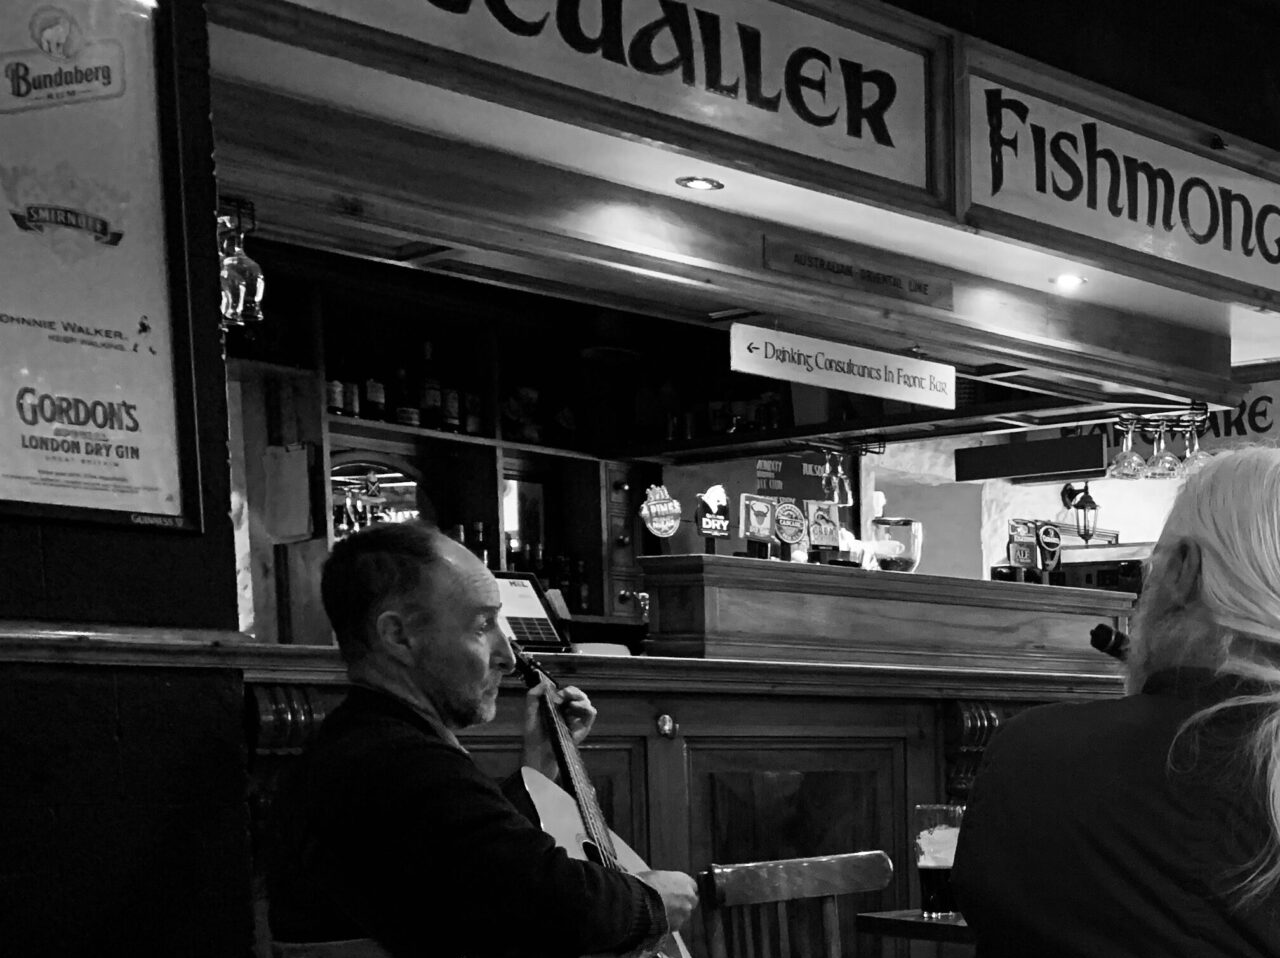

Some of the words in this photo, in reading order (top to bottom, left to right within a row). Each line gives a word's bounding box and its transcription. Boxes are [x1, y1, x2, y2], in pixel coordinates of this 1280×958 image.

[5, 62, 111, 98] Bundaberg
[0, 313, 57, 331] OHNNIE
[764, 342, 813, 372] Drinking
[815, 352, 881, 382] Consultants
[884, 365, 894, 384] In
[897, 368, 926, 389] Front
[929, 375, 948, 396] Bar
[16, 386, 140, 432] GORDON'S
[21, 434, 81, 454] LONDON
[85, 442, 112, 458] DRY
[115, 445, 140, 460] GIN
[702, 517, 729, 530] DRY
[1016, 549, 1030, 559] ALE
